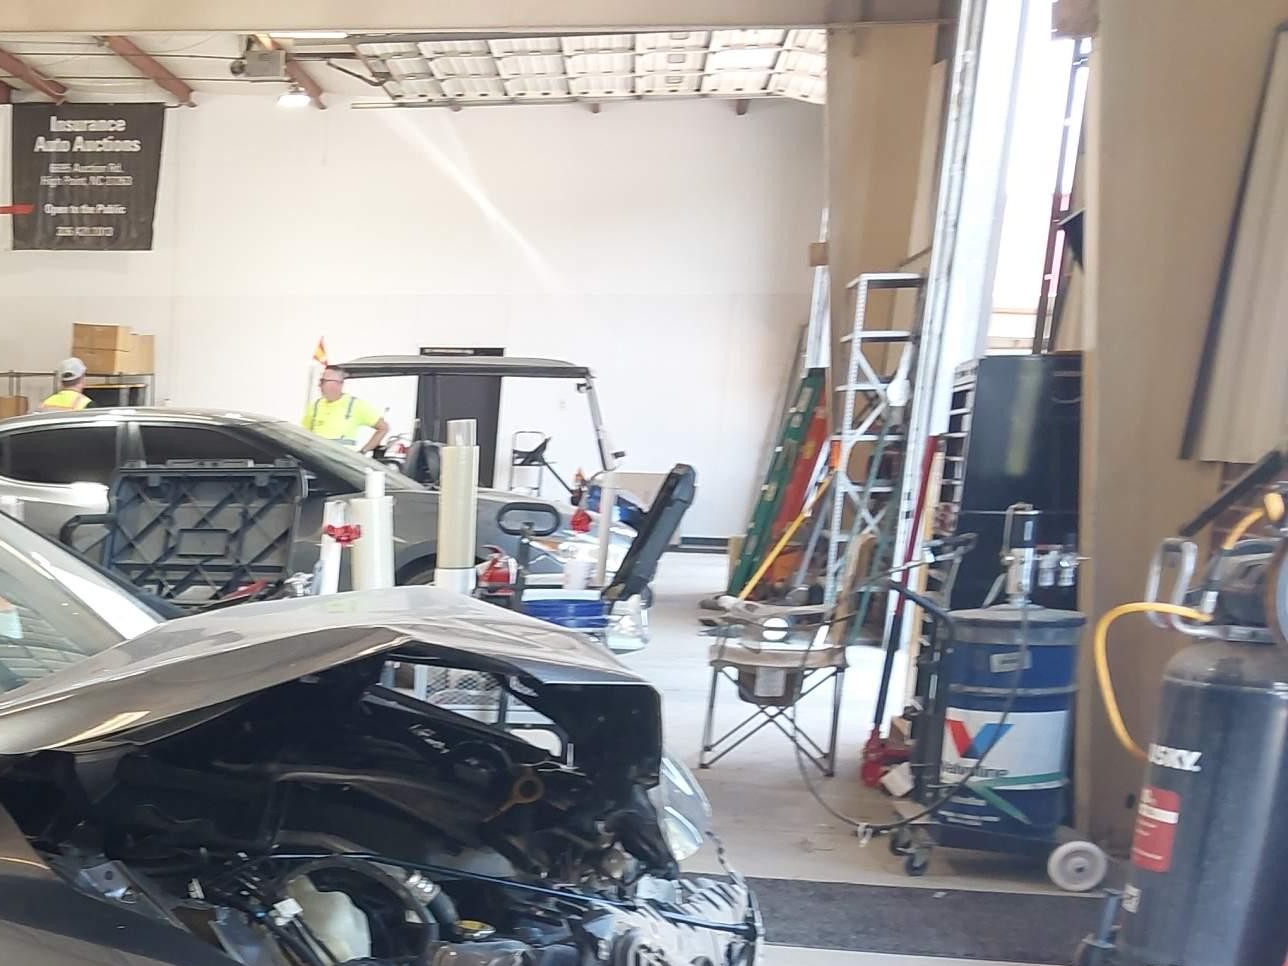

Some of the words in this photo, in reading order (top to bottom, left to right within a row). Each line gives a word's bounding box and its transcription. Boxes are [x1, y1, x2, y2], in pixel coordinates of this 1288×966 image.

[49, 116, 126, 132] Insurance
[33, 136, 71, 152] Auto
[72, 135, 142, 152] Auctions
[44, 203, 68, 216] Open
[69, 205, 79, 214] to
[80, 204, 95, 214] the
[96, 203, 127, 214] Public
